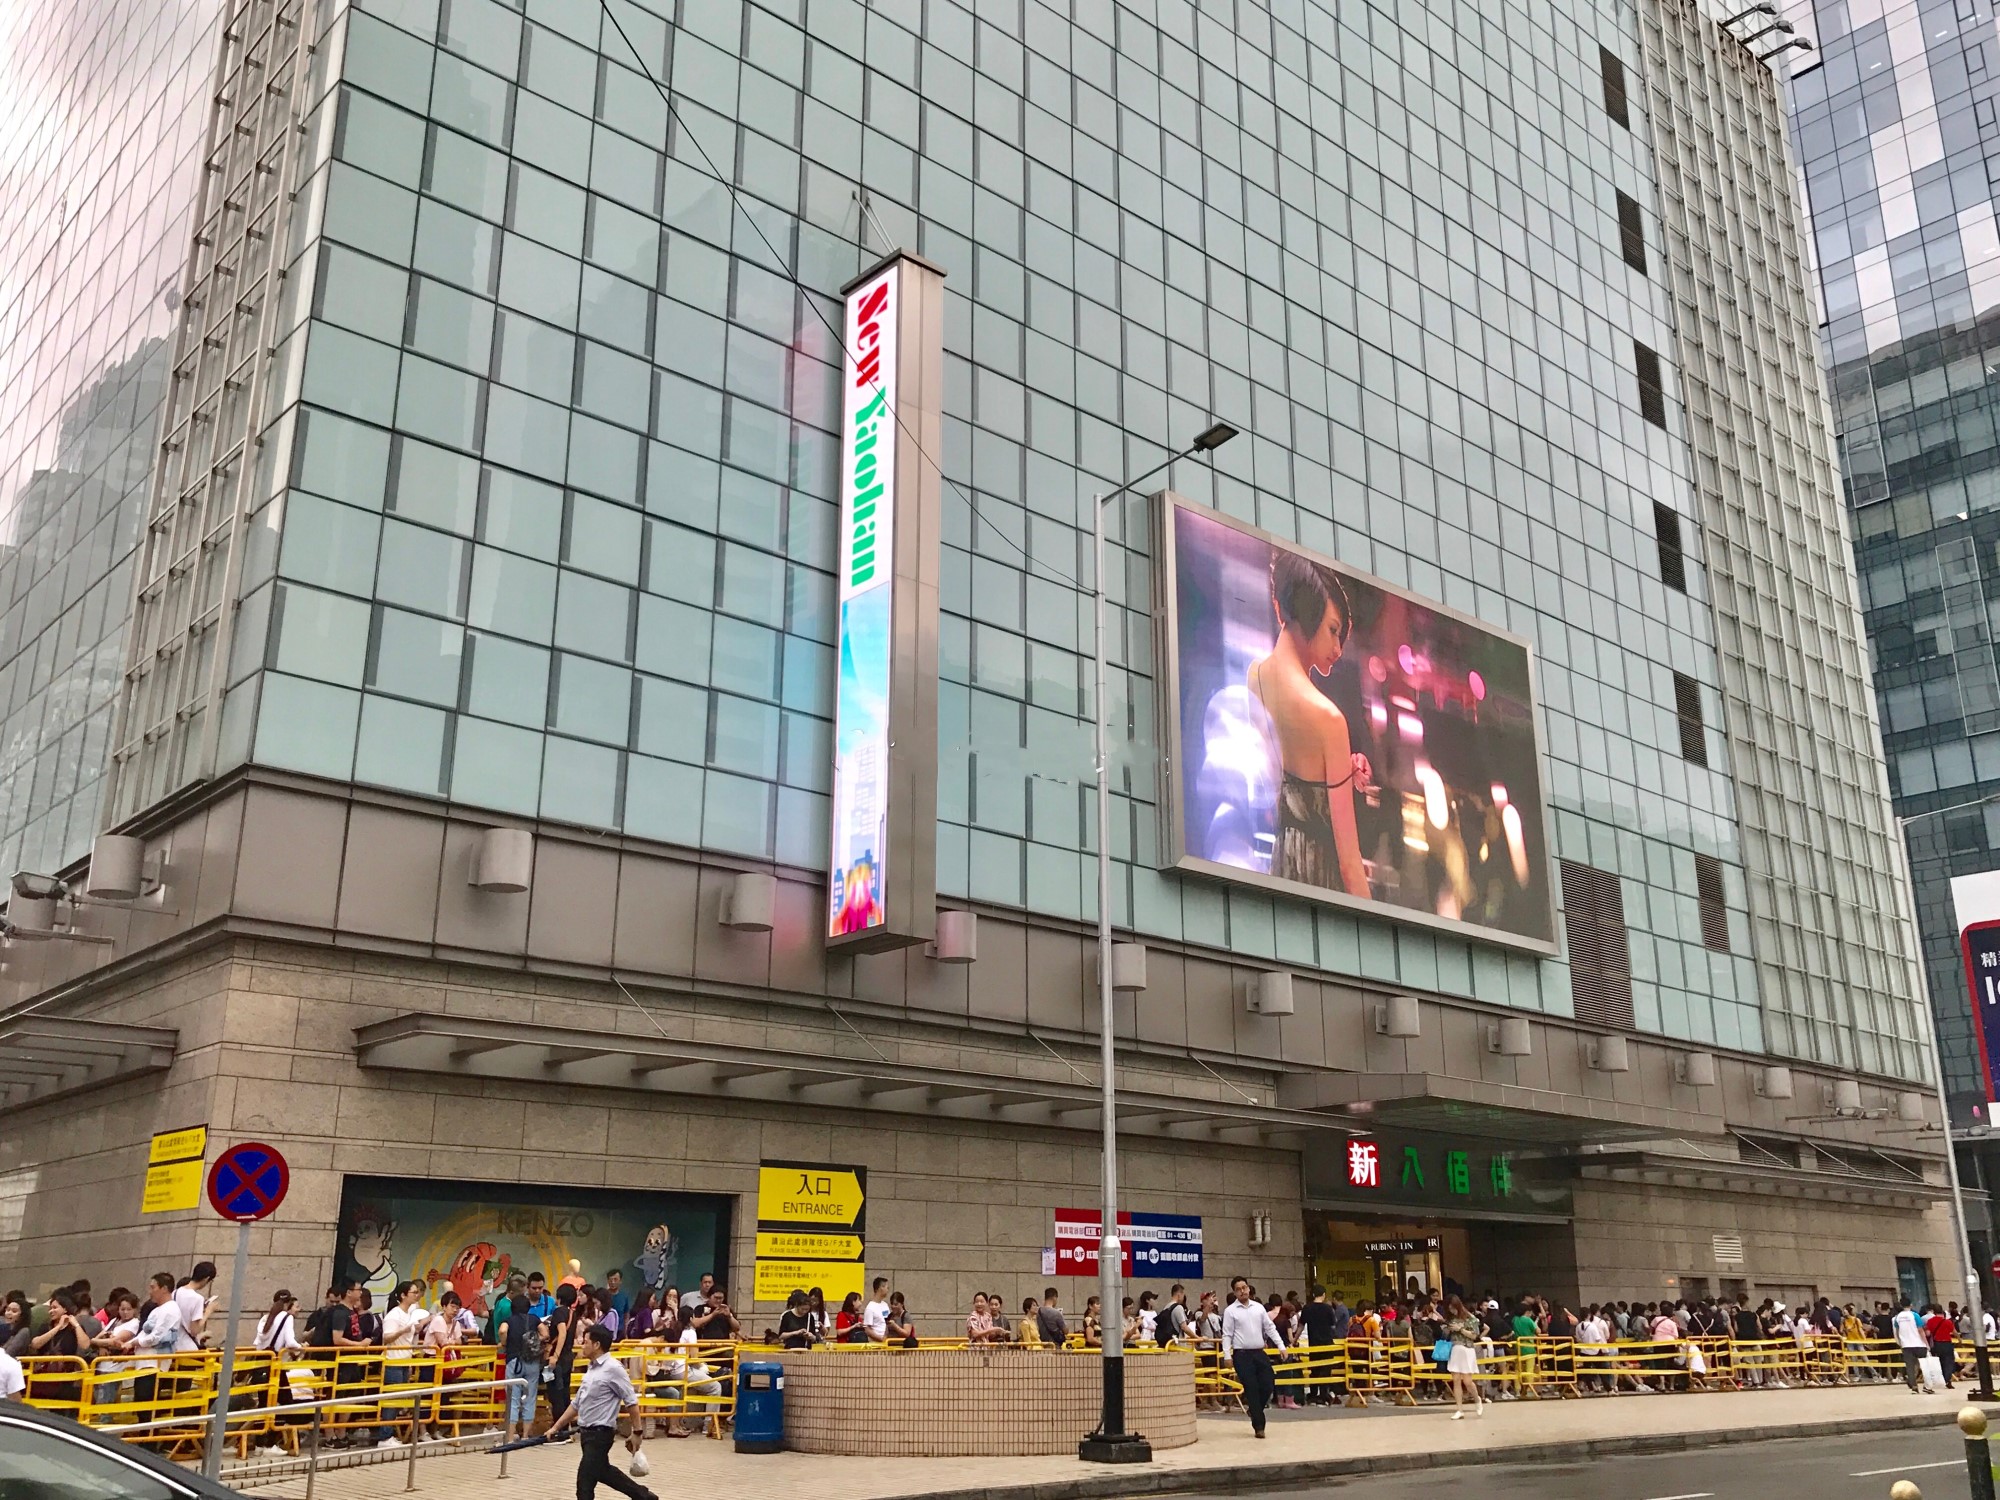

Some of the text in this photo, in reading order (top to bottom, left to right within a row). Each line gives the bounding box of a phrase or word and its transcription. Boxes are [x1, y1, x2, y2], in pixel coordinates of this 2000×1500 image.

[851, 282, 889, 587] New Yaohan
[796, 1173, 832, 1196] 入口
[783, 1202, 844, 1216] ENTRANCE
[497, 1209, 595, 1238] KENZO
